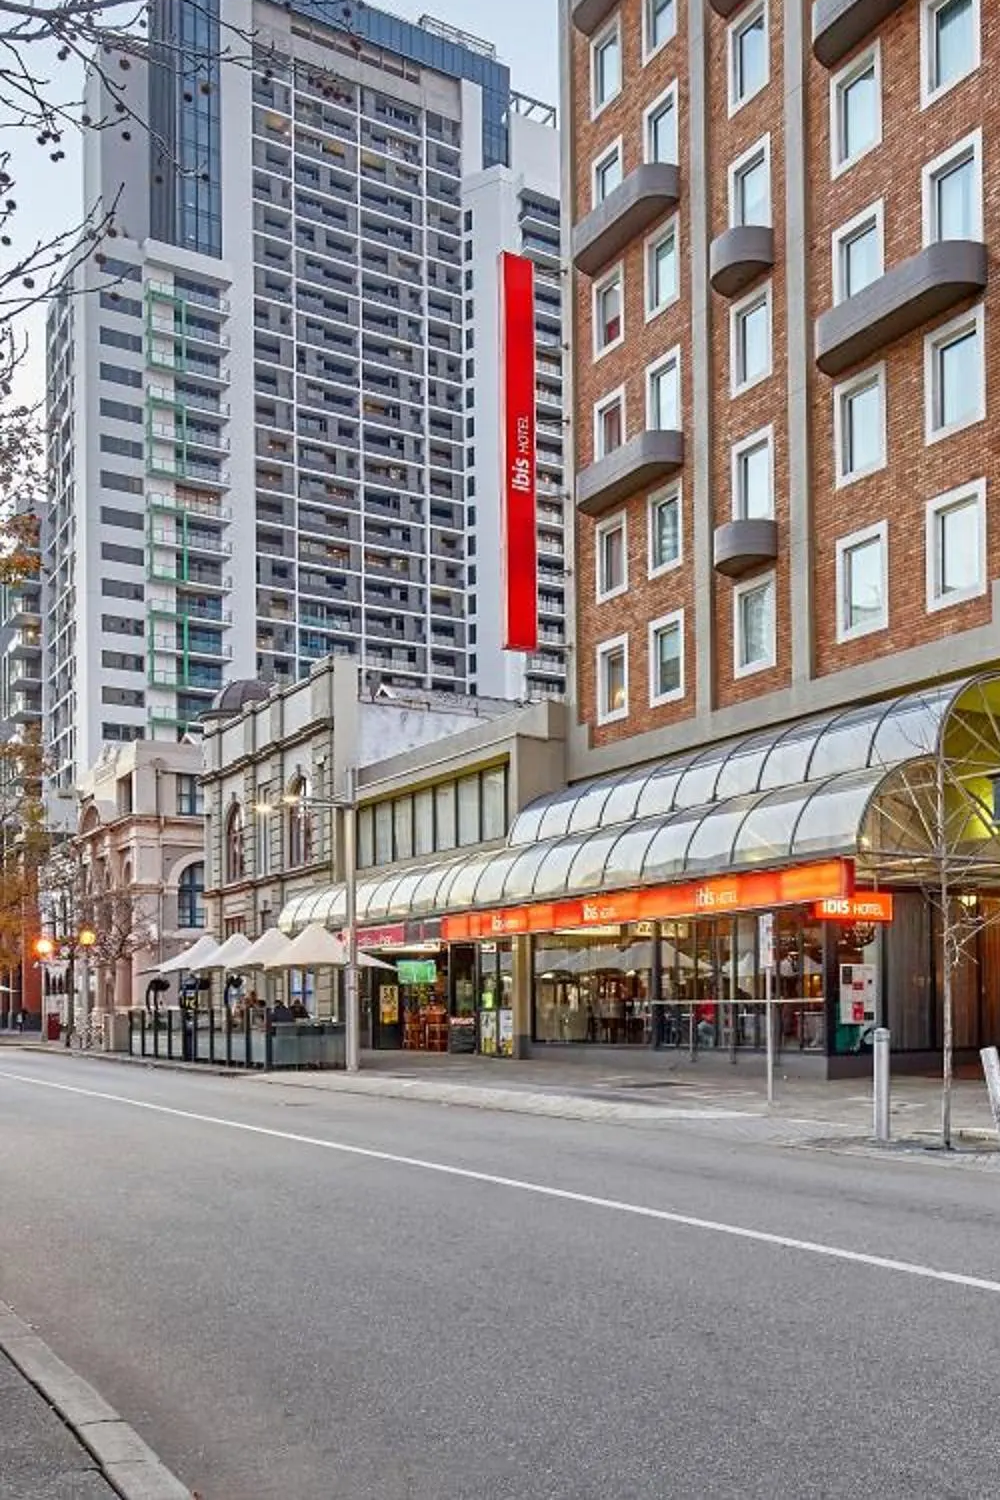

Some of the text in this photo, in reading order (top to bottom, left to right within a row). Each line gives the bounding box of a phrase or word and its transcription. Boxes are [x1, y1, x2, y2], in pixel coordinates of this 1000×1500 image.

[512, 416, 530, 493] ibis HOTEL
[695, 887, 715, 907] ibis
[853, 902, 883, 916] HOTEL
